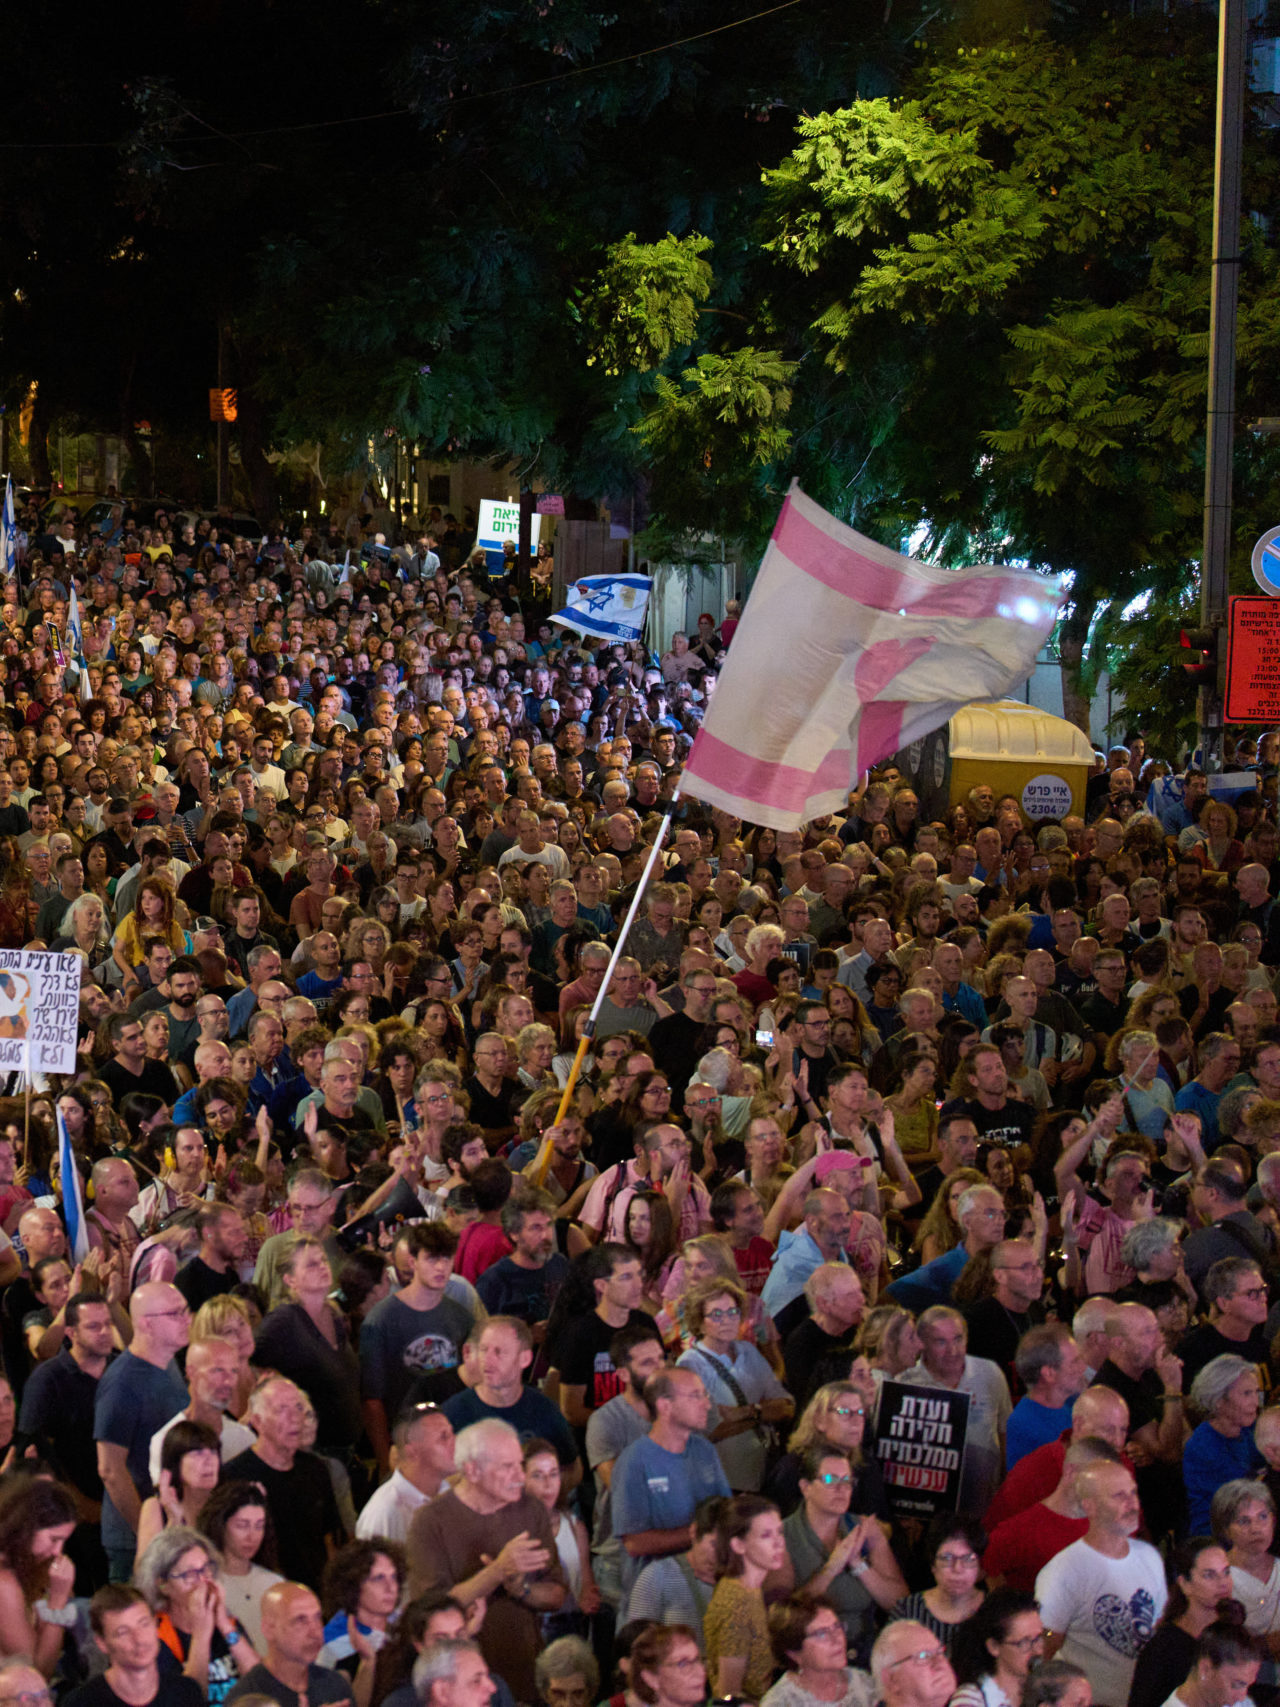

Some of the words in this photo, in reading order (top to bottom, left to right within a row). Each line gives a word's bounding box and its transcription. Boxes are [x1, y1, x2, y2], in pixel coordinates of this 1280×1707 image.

[493, 521, 520, 533] ירום
[1027, 785, 1051, 796] פרש
[56, 954, 77, 973] שאו
[65, 974, 80, 991] לא
[33, 1007, 50, 1024] שיר
[32, 1025, 76, 1044] לאהבה
[40, 1044, 64, 1065] ולא
[900, 1395, 950, 1422] ועדת
[889, 1415, 953, 1445] חקירה
[876, 1437, 960, 1470] ממלכתית
